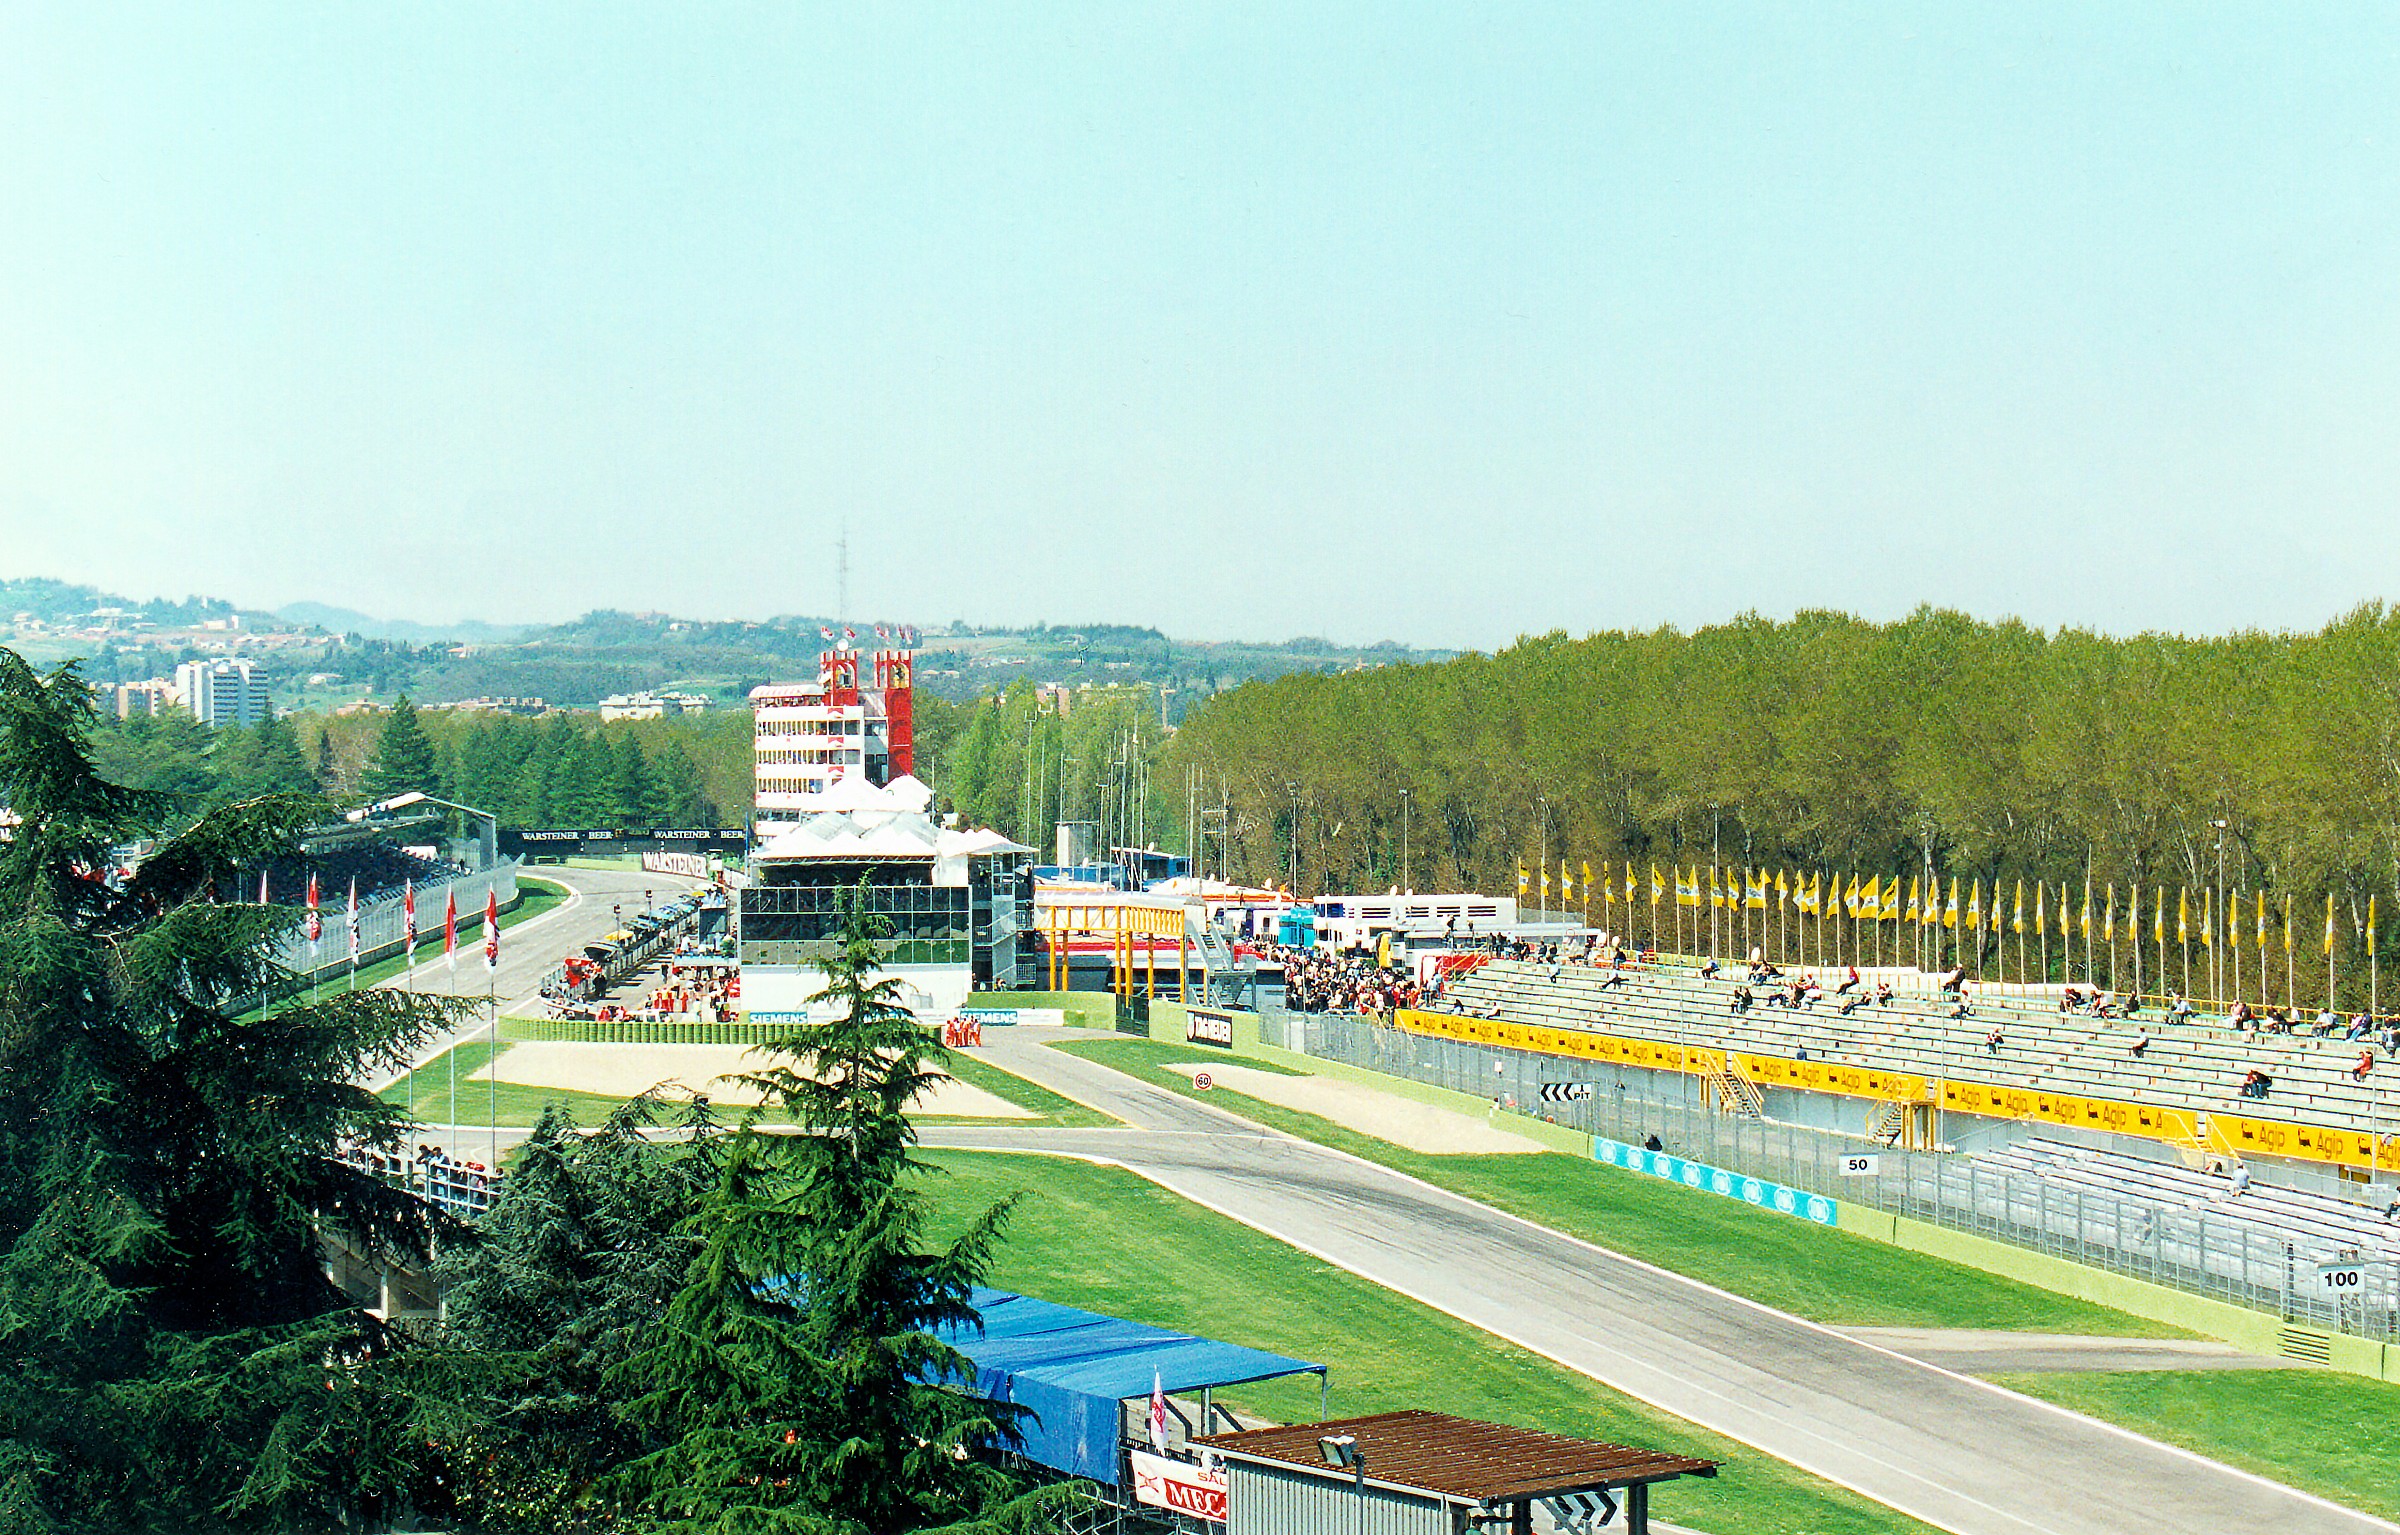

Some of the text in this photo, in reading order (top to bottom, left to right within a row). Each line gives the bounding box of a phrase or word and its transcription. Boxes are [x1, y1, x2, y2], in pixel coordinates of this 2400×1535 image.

[522, 831, 612, 840] WARSTEINER BEER
[653, 830, 744, 839] WARSTEINER BEER
[642, 852, 708, 878] WARSTEINER
[750, 1013, 807, 1024] SIEMENS
[1198, 1077, 1209, 1086] 60
[1573, 1092, 1590, 1100] PIT
[2005, 1092, 2028, 1117] Agip
[2054, 1098, 2077, 1123] Agip
[2103, 1103, 2127, 1130] Agip
[2258, 1123, 2285, 1151] Agip
[2316, 1130, 2344, 1159] Agip
[1849, 1159, 1867, 1170] 50
[2325, 1271, 2358, 1286] 100
